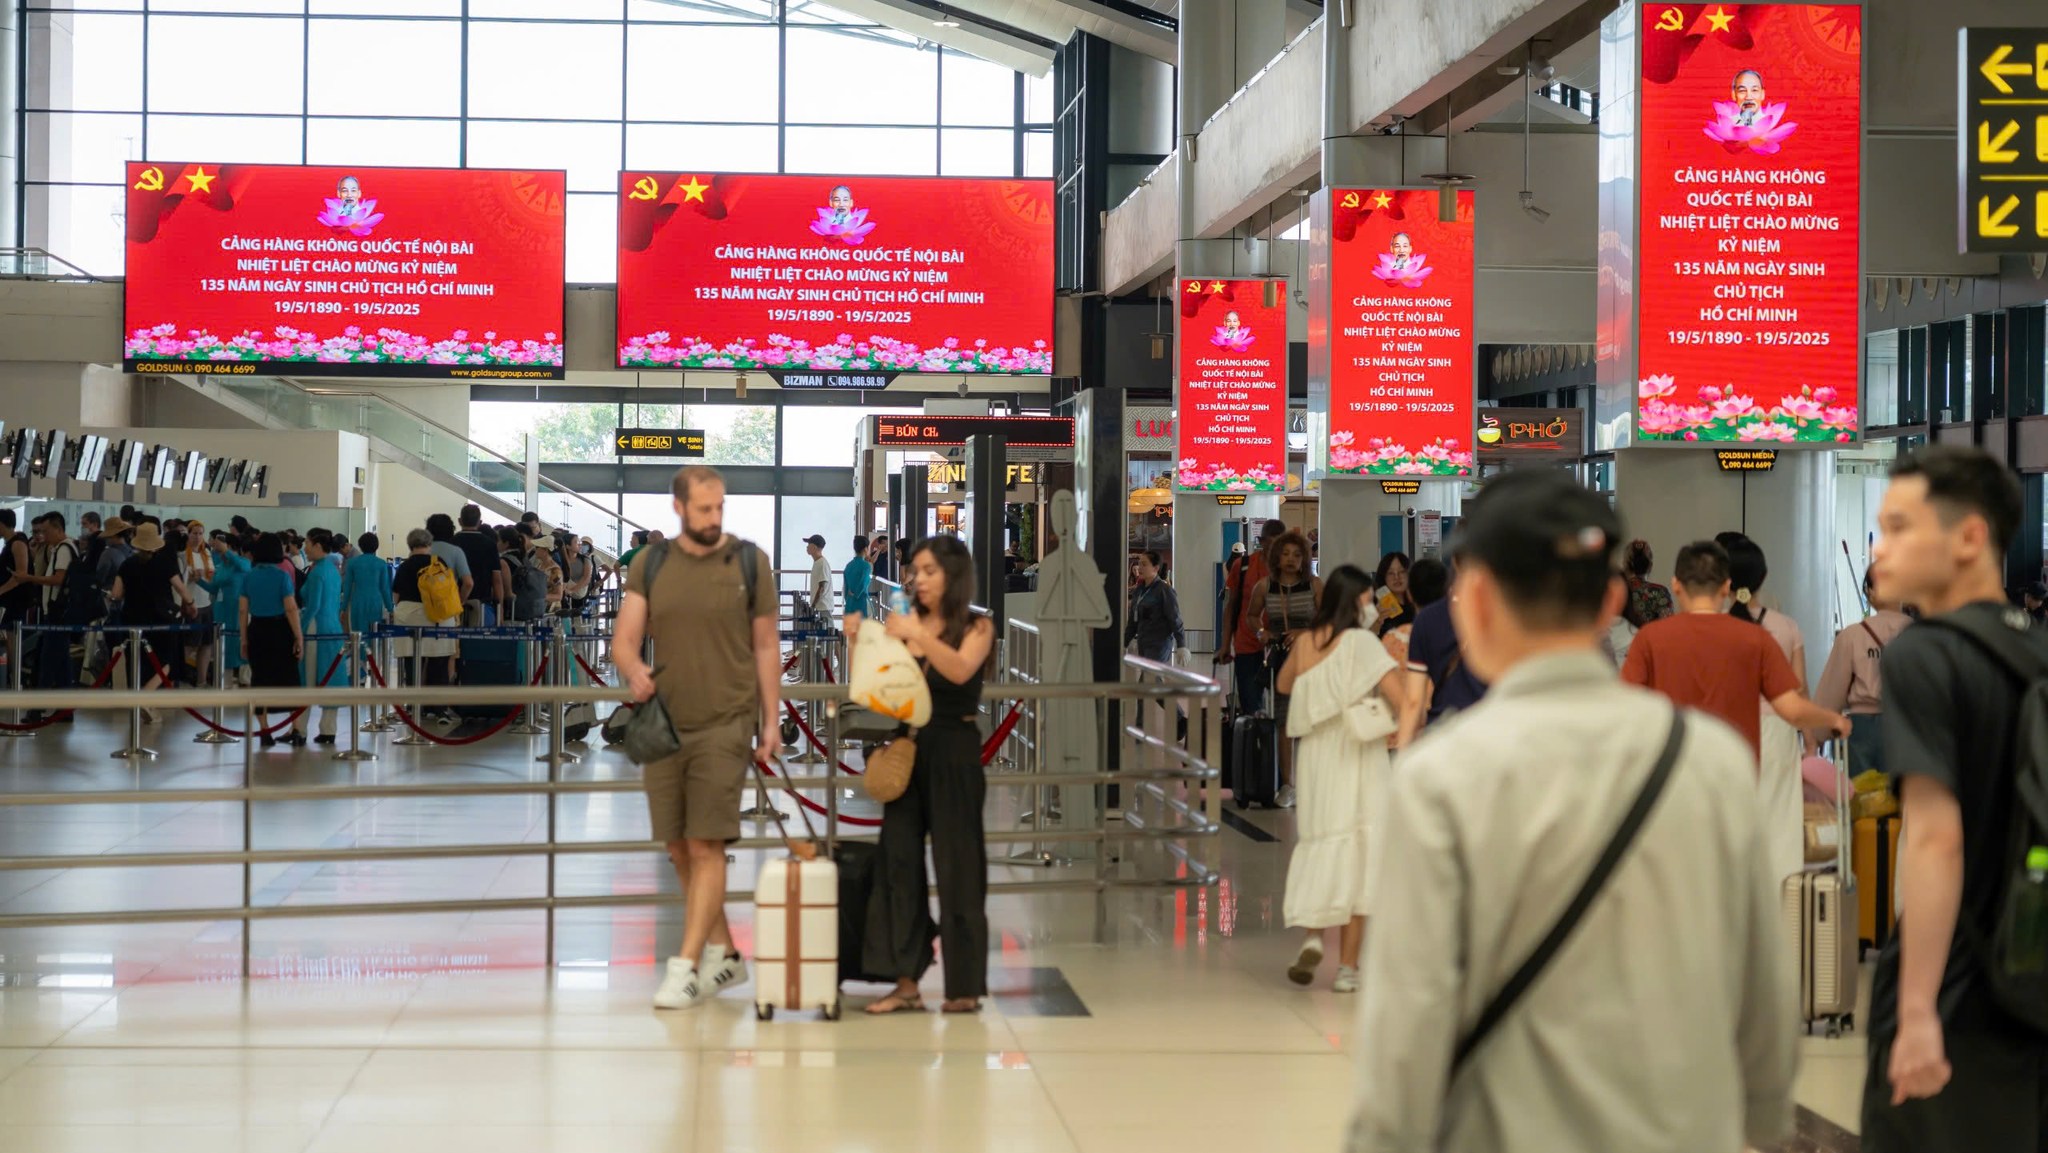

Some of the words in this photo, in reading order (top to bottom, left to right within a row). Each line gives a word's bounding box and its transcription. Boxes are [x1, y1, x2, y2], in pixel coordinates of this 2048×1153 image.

[1675, 167, 1718, 183] CẢNG
[1722, 168, 1766, 183] HÀNG
[1770, 169, 1825, 184] KHÔNG
[1687, 190, 1732, 207] QUỐC
[1735, 190, 1752, 206] TẾ
[1756, 191, 1783, 209] NỘI
[1788, 192, 1812, 206] BÀI
[1661, 214, 1706, 231] NHIỆT
[1710, 214, 1740, 232] LIỆT
[1744, 214, 1787, 229] CHÀO
[1791, 215, 1838, 230] MỪNG
[222, 235, 261, 250] CẢNG
[264, 237, 304, 251] HÀNG
[308, 238, 358, 252] KHÔNG
[361, 238, 401, 253] QUỐC
[403, 239, 420, 253] TẾ
[423, 240, 447, 256] NỘI
[451, 241, 473, 254] BÀI
[1719, 236, 1738, 251] KỶ
[1742, 237, 1780, 255] NIỆM
[715, 244, 754, 259] CẢNG
[757, 246, 797, 259] HÀNG
[800, 247, 850, 260] KHÔNG
[853, 247, 892, 262] QUỐC
[895, 248, 911, 262] TẾ
[914, 249, 938, 265] NỘI
[942, 249, 964, 262] BÀI
[238, 257, 279, 274] NHIỆT
[282, 258, 310, 274] LIỆT
[312, 259, 352, 272] CHÀO
[355, 259, 398, 273] MỪNG
[402, 259, 419, 273] KỶ
[422, 261, 457, 277] NIỆM
[1674, 262, 1700, 274] 135
[1704, 260, 1740, 274] NĂM
[1744, 260, 1785, 275] NGÀY
[1789, 263, 1824, 275] SINH
[731, 266, 771, 282] NHIỆT
[775, 267, 802, 282] LIỆT
[805, 267, 844, 280] CHÀO
[847, 268, 890, 281] MỪNG
[893, 268, 910, 282] KỶ
[914, 269, 947, 285] NIỆM
[201, 280, 225, 290] 135
[228, 278, 260, 291] NĂM
[264, 278, 301, 292] NGÀY
[305, 281, 337, 292] SINH
[340, 279, 369, 293] CHỦ
[372, 283, 403, 296] TỊCH
[430, 282, 454, 294] CHÍ
[457, 284, 493, 295] MINH
[1714, 282, 1746, 298] CHỦ
[1749, 286, 1783, 301] TỊCH
[695, 288, 718, 299] 135
[722, 286, 754, 299] NĂM
[757, 287, 794, 300] NGÀY
[797, 289, 829, 300] SINH
[832, 287, 861, 301] CHỦ
[864, 291, 894, 304] TỊCH
[922, 290, 945, 302] CHÍ
[948, 292, 984, 303] MINH
[275, 302, 342, 313] 19/5/1890
[353, 303, 419, 315] 19/5/2025
[768, 309, 834, 321] 19/5/1890
[845, 311, 911, 322] 19/5/2025
[1727, 306, 1752, 321] CHÍ
[1757, 309, 1797, 321] MINH
[1669, 331, 1742, 344] 19/5/1890
[1756, 332, 1829, 345] 19/5/2025
[137, 364, 182, 372] GOLDSUN
[195, 365, 212, 373] 090
[214, 365, 230, 373] 464
[233, 365, 255, 373] 6699
[1354, 358, 1370, 366] 135
[1428, 358, 1451, 366] SINH
[451, 370, 552, 378] www.goldsungroup.com.vn
[784, 376, 822, 385] BIZMAN
[838, 376, 885, 386] 094.986.98.98
[1406, 388, 1433, 396] MINH
[1350, 403, 1398, 411] 19/5/1890
[1406, 403, 1454, 411] 19/5/2025
[896, 424, 918, 436] BÚN
[923, 427, 938, 437] CH
[1509, 417, 1567, 438] PHỞ
[1728, 461, 1741, 469] 090
[1742, 461, 1754, 469] 464
[1756, 461, 1771, 469] 6699
